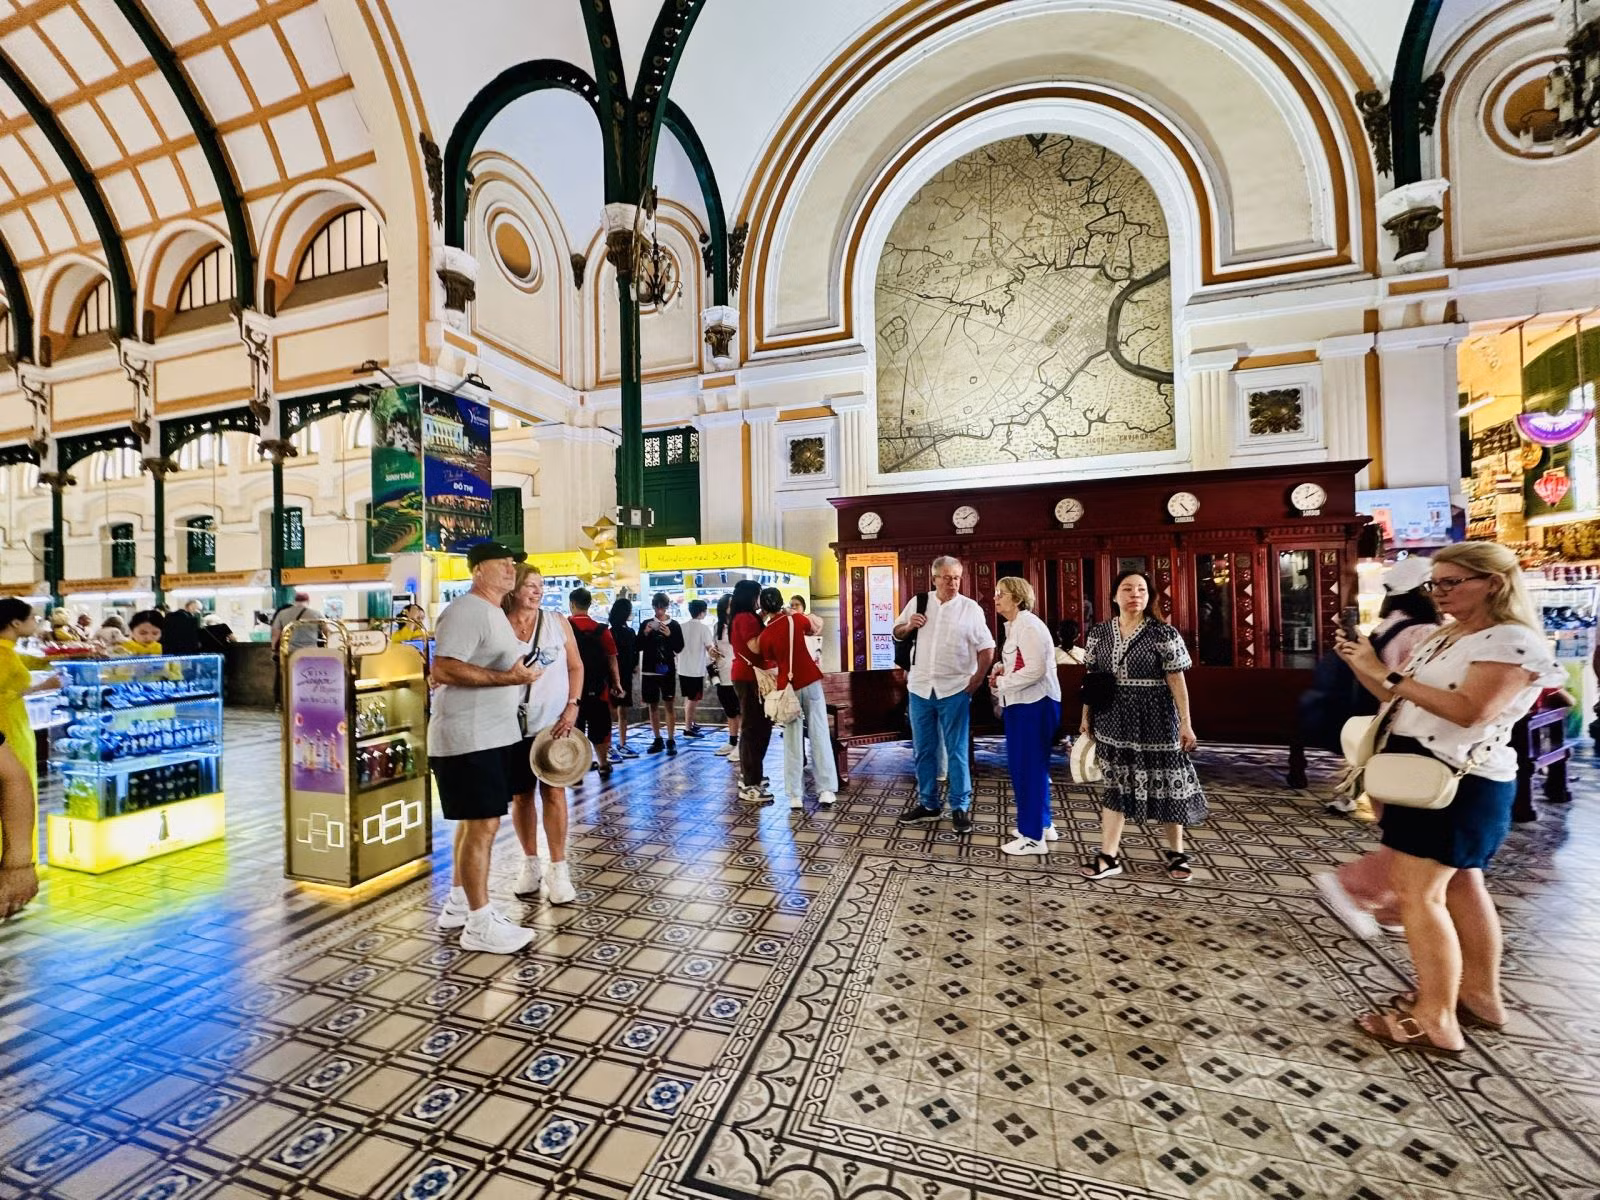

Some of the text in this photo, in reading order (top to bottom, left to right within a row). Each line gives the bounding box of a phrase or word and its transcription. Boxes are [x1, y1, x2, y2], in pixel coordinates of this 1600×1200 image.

[1064, 562, 1075, 573] 11
[1157, 559, 1169, 569] 12
[854, 569, 861, 579] 8
[979, 564, 989, 575] 10
